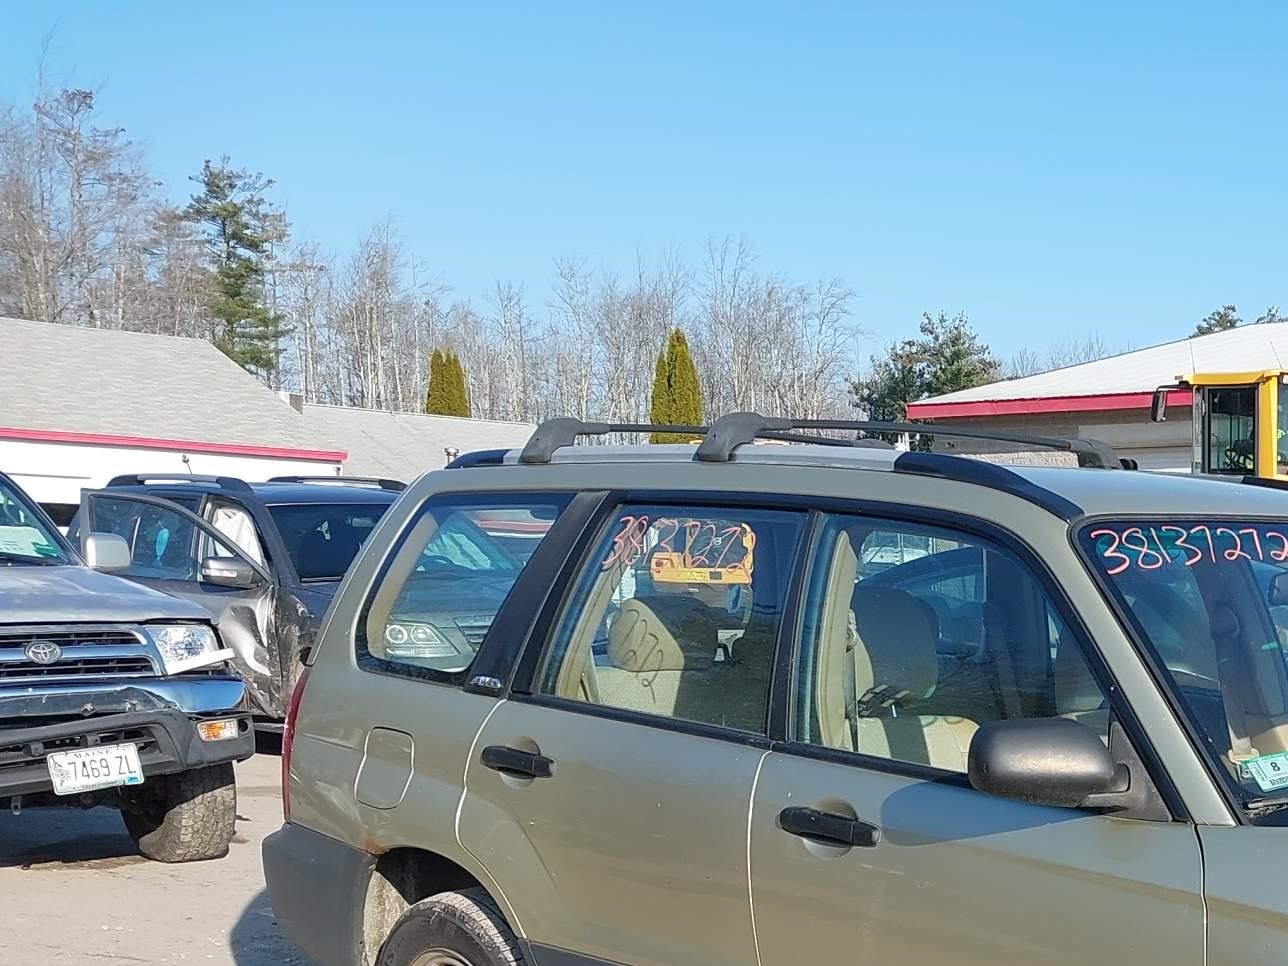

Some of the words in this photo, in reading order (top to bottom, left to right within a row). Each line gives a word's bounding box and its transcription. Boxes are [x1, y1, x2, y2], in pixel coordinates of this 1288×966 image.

[67, 758, 111, 780] 7469
[115, 755, 137, 775] ZL
[1270, 761, 1281, 772] 8
